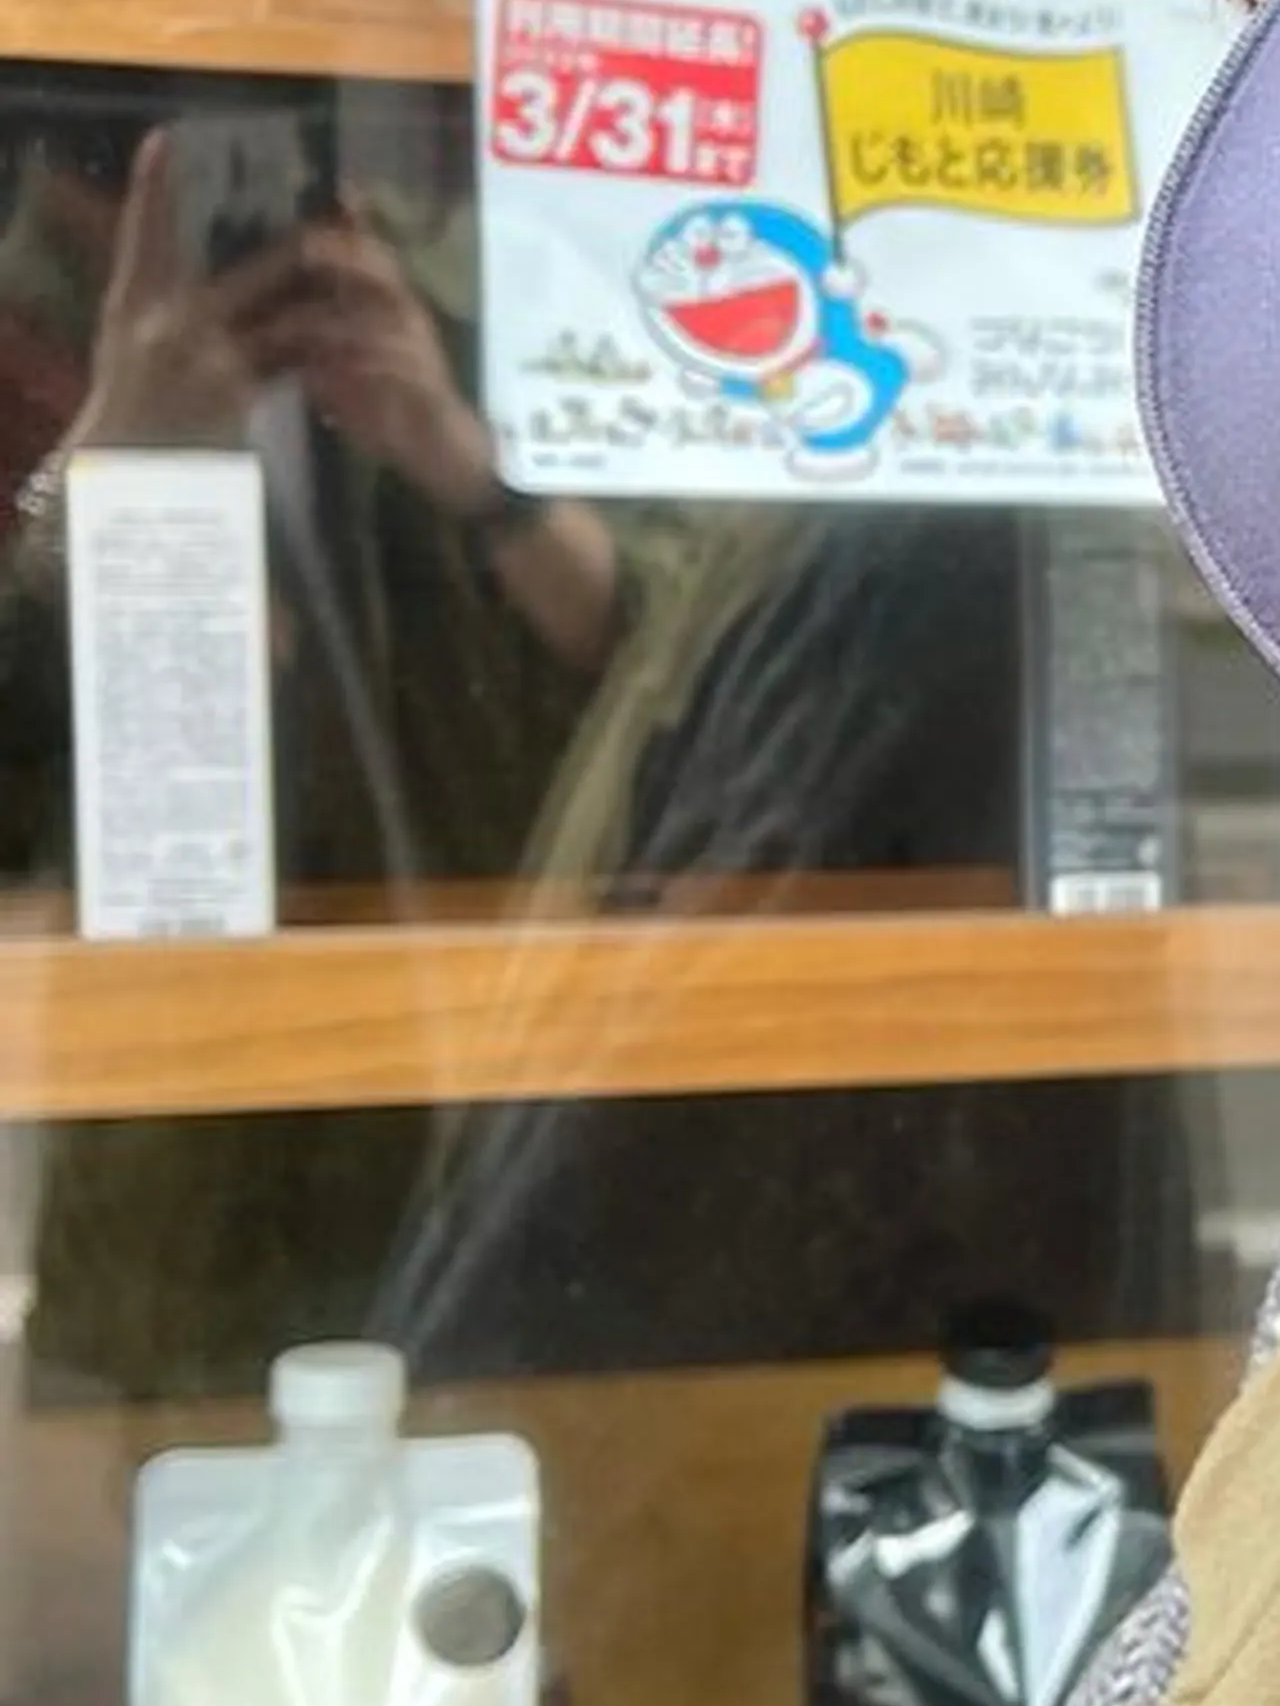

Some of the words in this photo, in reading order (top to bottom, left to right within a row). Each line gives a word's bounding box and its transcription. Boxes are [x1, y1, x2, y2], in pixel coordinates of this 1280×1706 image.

[497, 71, 695, 172] 3/31
[930, 67, 1026, 130] 川崎
[851, 129, 1114, 200] じもと応援券
